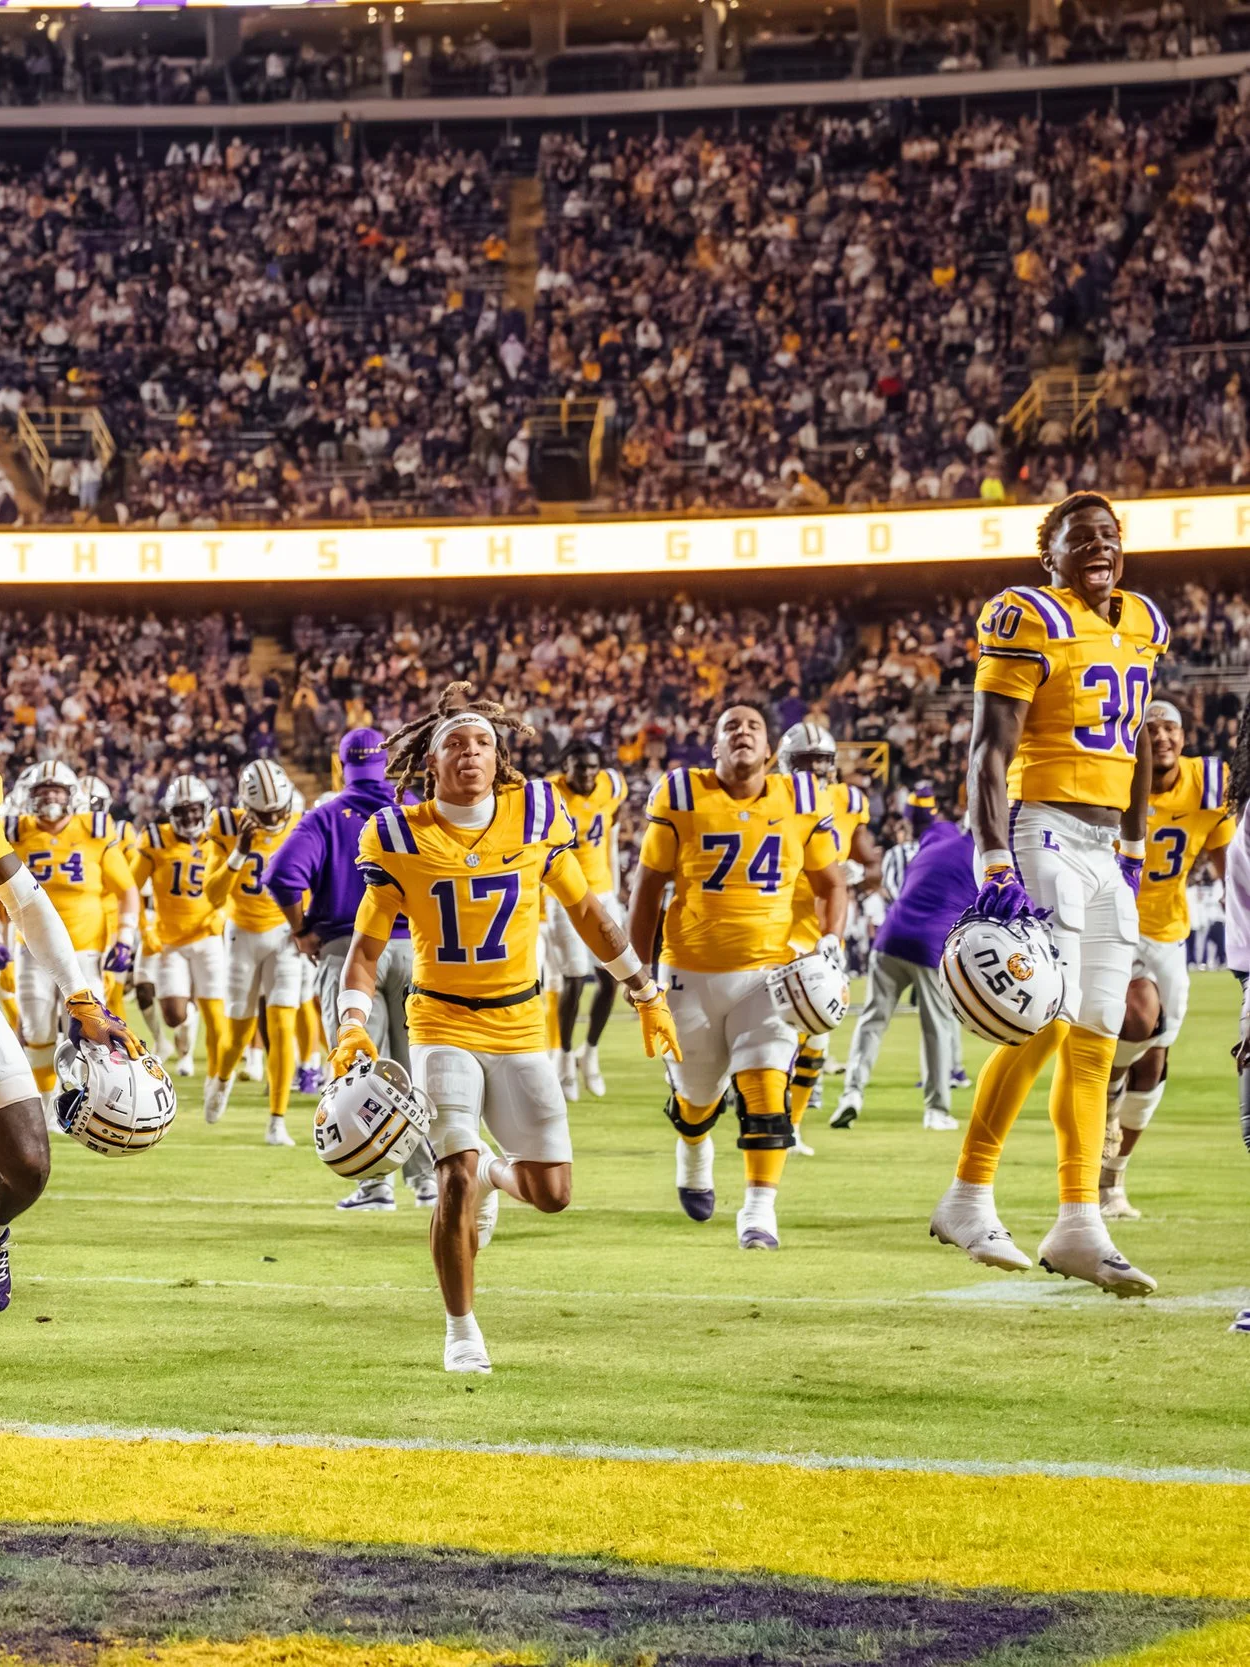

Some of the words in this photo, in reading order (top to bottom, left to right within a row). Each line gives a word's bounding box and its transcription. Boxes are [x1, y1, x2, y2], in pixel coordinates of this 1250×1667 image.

[12, 537, 340, 574] THAT'S
[425, 532, 577, 568] THE
[665, 521, 891, 562] GOOD
[981, 600, 1024, 640] 30
[1072, 662, 1151, 756] 30
[28, 851, 84, 885] 54
[169, 860, 206, 898] 15
[701, 833, 782, 895] 74
[429, 869, 522, 966] 17
[385, 1086, 426, 1127] TIGERS
